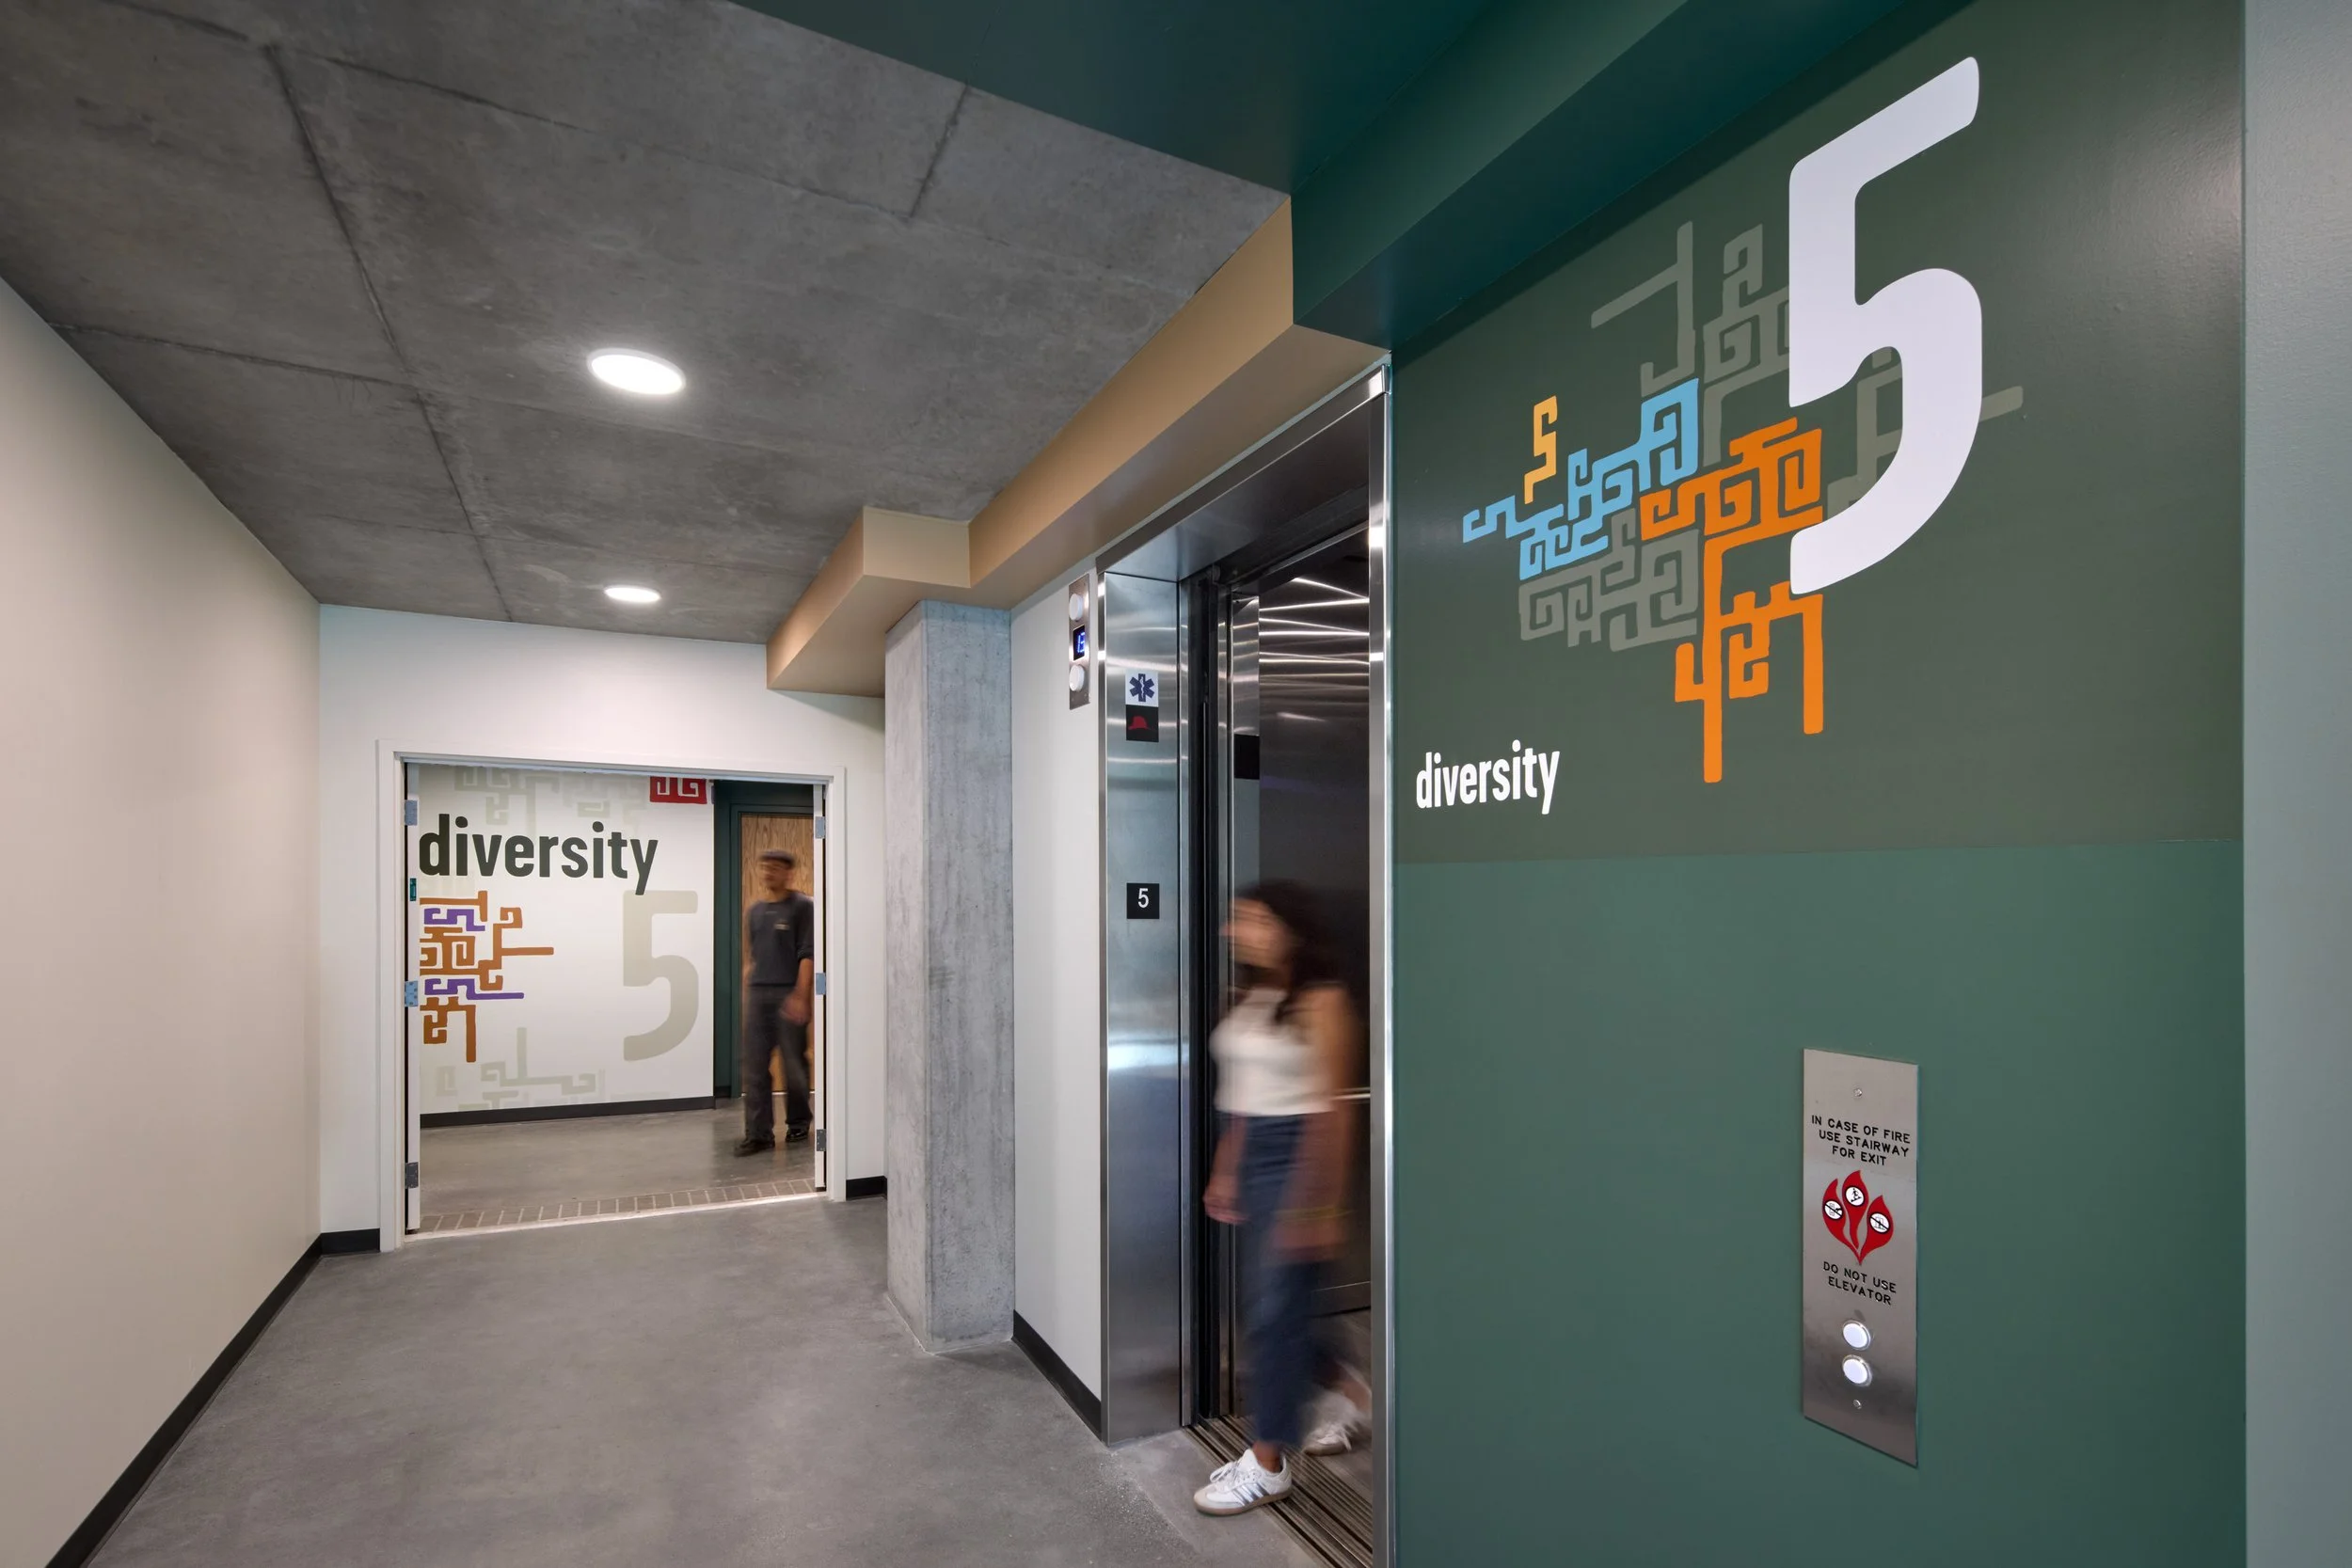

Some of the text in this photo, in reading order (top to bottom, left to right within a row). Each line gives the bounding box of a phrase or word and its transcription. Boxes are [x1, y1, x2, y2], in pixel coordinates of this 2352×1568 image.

[1789, 56, 1982, 594] 5
[1416, 739, 1561, 816] diversity
[420, 813, 659, 896] diversity
[1137, 887, 1150, 909] 5
[623, 890, 699, 1061] 5
[1811, 1115, 1911, 1144] IN CASE OF FIRE
[1819, 1130, 1909, 1158] USE STAIRWAY
[1832, 1146, 1887, 1166] FOR EXIT
[1823, 1260, 1897, 1294] DO NOT USE
[1828, 1275, 1891, 1306] ELEVATOR
